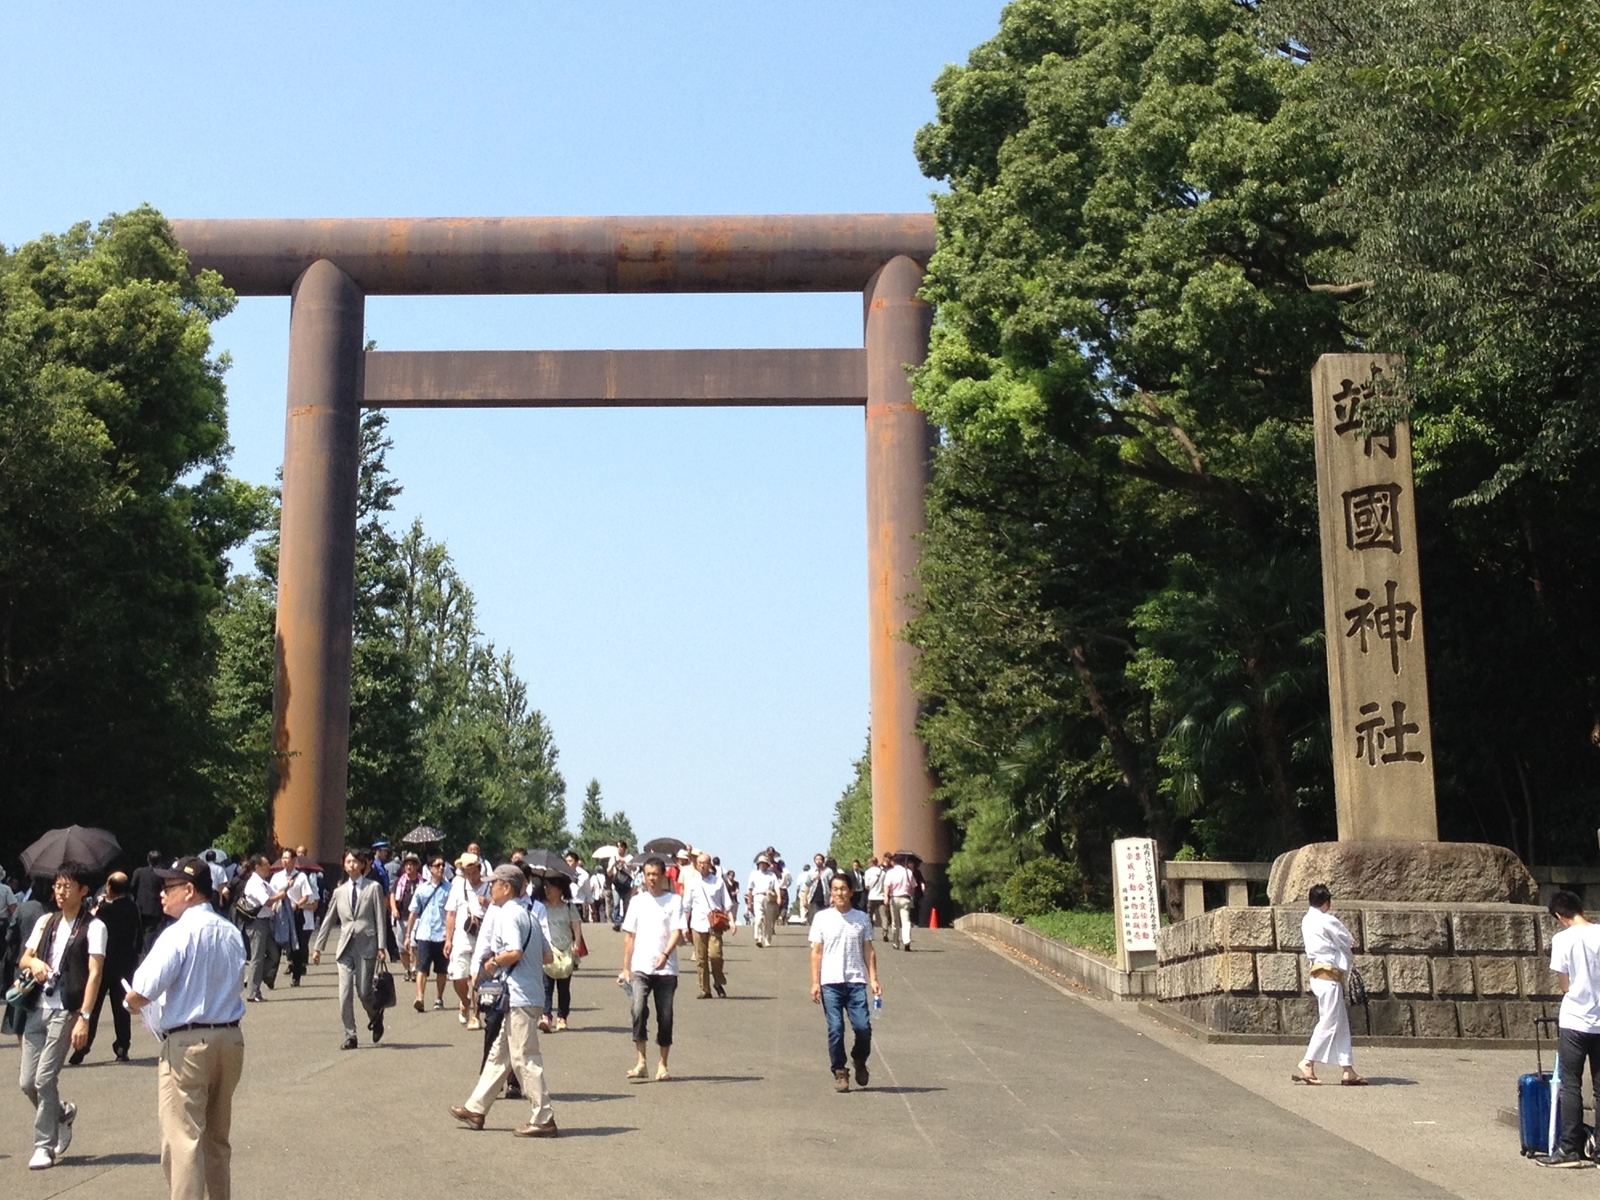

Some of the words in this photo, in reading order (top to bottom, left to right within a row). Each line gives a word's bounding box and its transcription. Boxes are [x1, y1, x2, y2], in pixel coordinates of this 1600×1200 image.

[1332, 361, 1425, 766] 靖國神社
[1126, 852, 1137, 891] 示威行動
[1130, 902, 1142, 940] 物品販売
[1139, 902, 1150, 940] 宣伝活動
